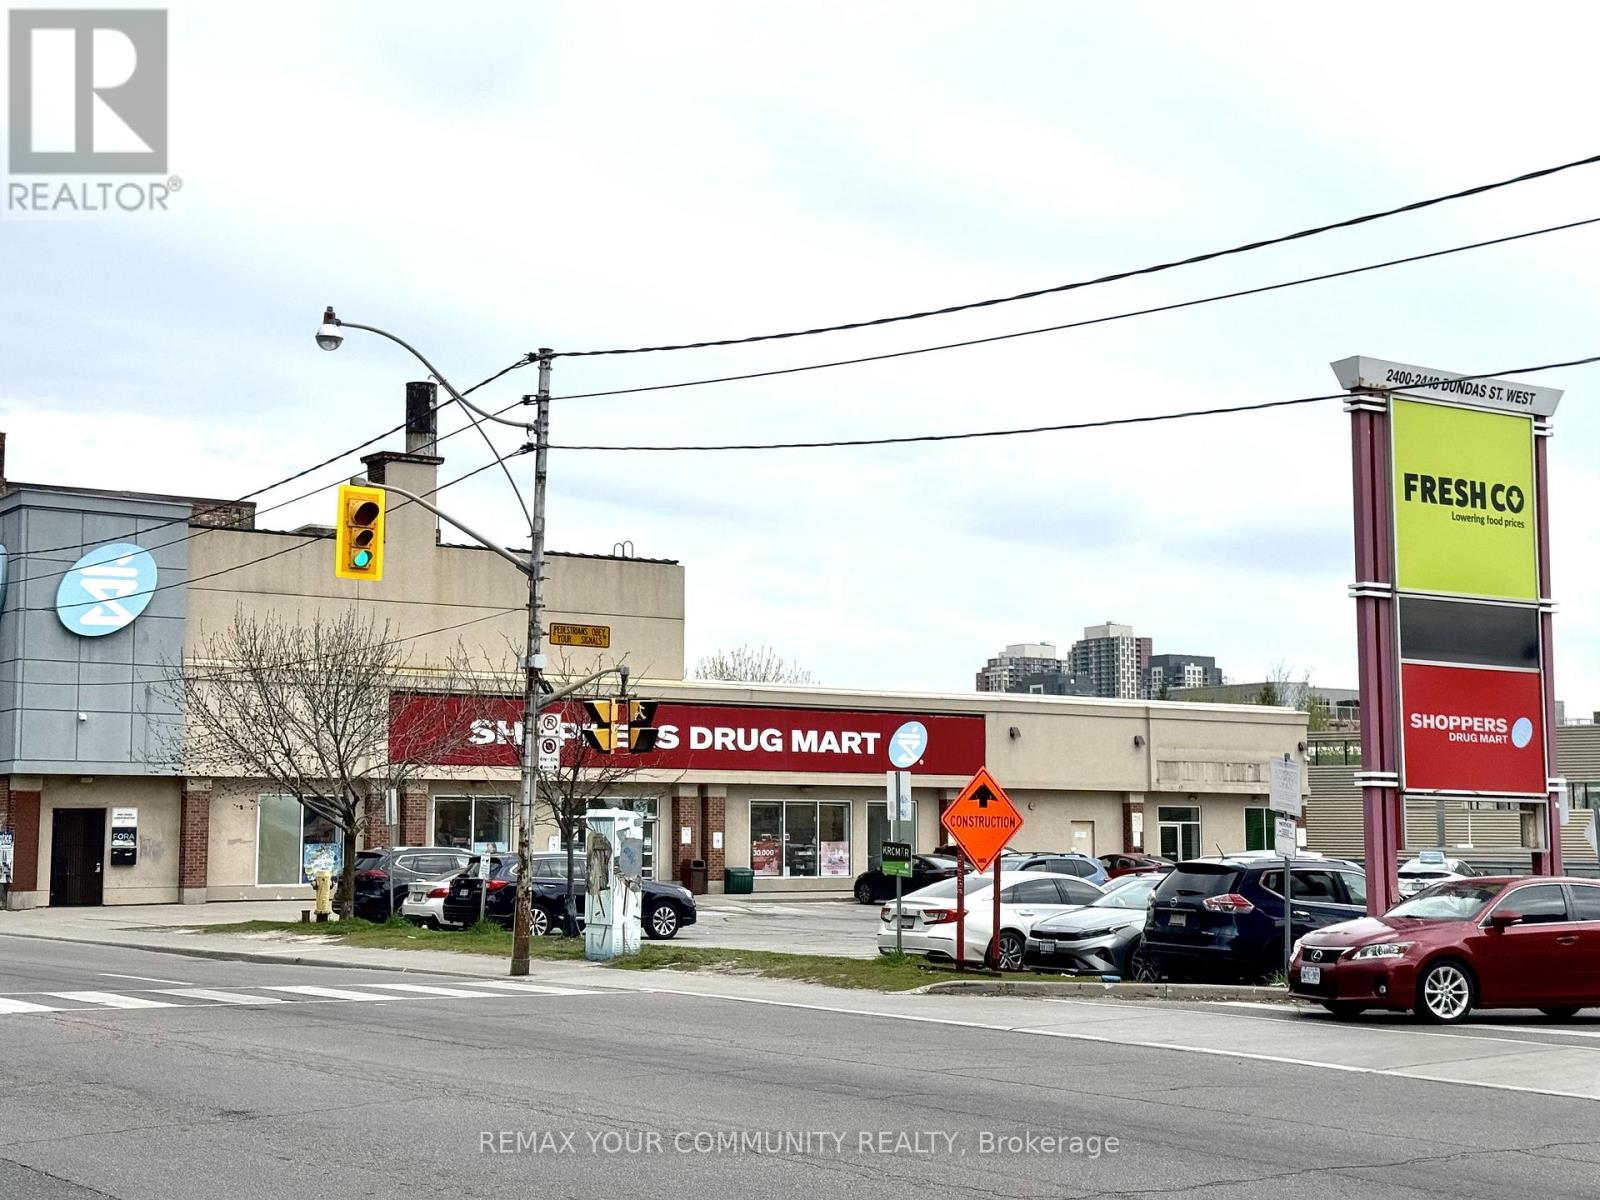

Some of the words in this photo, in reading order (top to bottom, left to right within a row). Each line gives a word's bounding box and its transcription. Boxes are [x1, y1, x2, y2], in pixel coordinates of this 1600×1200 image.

[1441, 379, 1487, 398] DUNDAS
[1488, 386, 1503, 401] ST.
[1506, 389, 1536, 406] WEST
[1451, 511, 1485, 526] Lowering
[1486, 515, 1503, 526] food
[1504, 517, 1525, 529] prices
[554, 626, 588, 635] PEDESTRIANS
[592, 628, 606, 636] OBEY
[558, 635, 571, 643] YOUR
[581, 636, 602, 645] SIGNALS
[1410, 713, 1507, 733] SHOPPERS
[689, 726, 783, 752] DRUG
[791, 729, 881, 755] MART
[1449, 732, 1478, 743] DRUG
[1480, 734, 1508, 744] MART
[950, 815, 1016, 828] CONSTRUCTION
